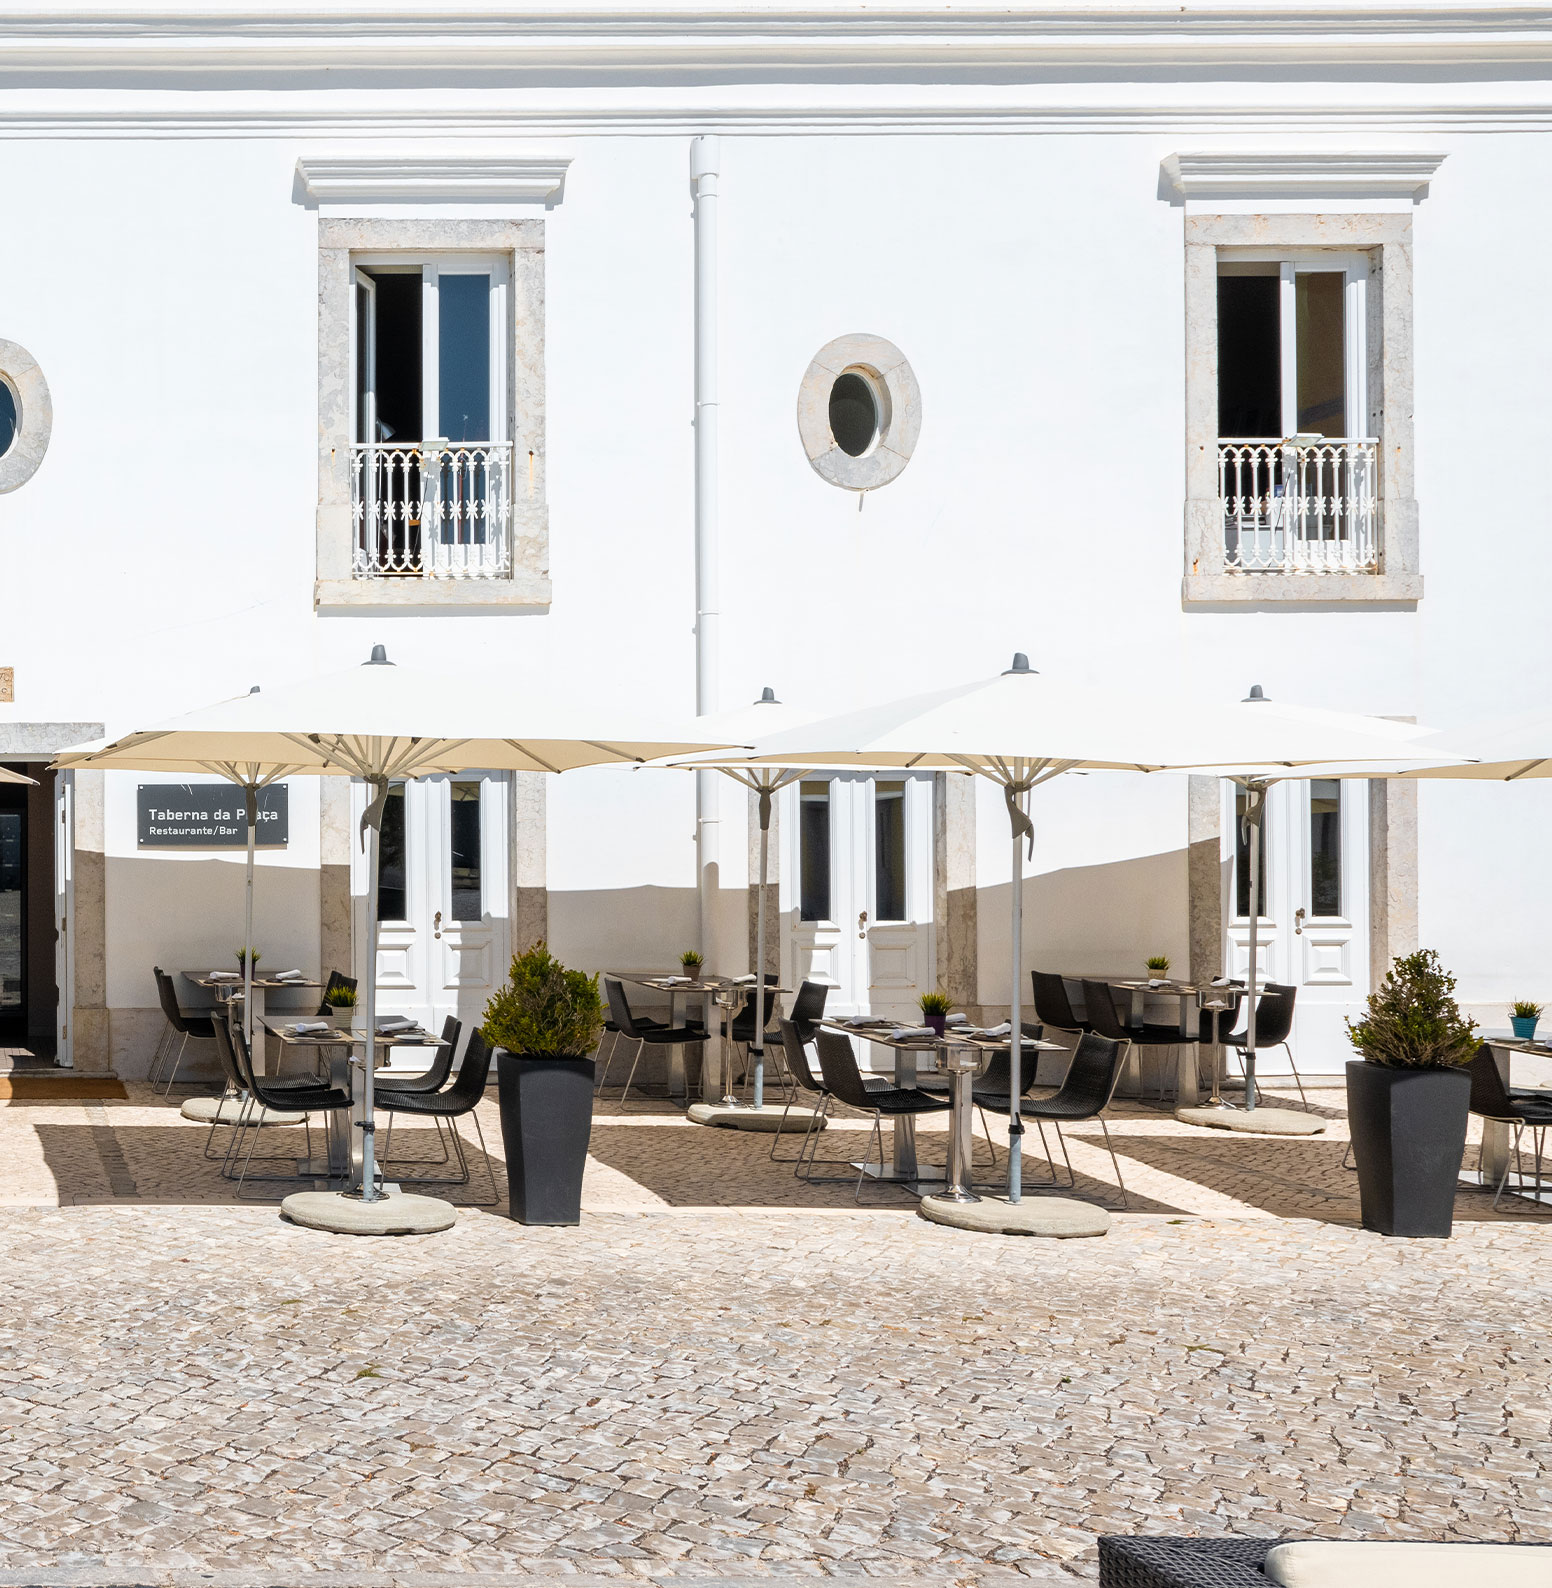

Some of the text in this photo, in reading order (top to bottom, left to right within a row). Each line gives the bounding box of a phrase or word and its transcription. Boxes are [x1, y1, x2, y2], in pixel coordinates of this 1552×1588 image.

[149, 809, 278, 823] Taberna da Paça
[149, 825, 237, 835] Restaurante/Bar
